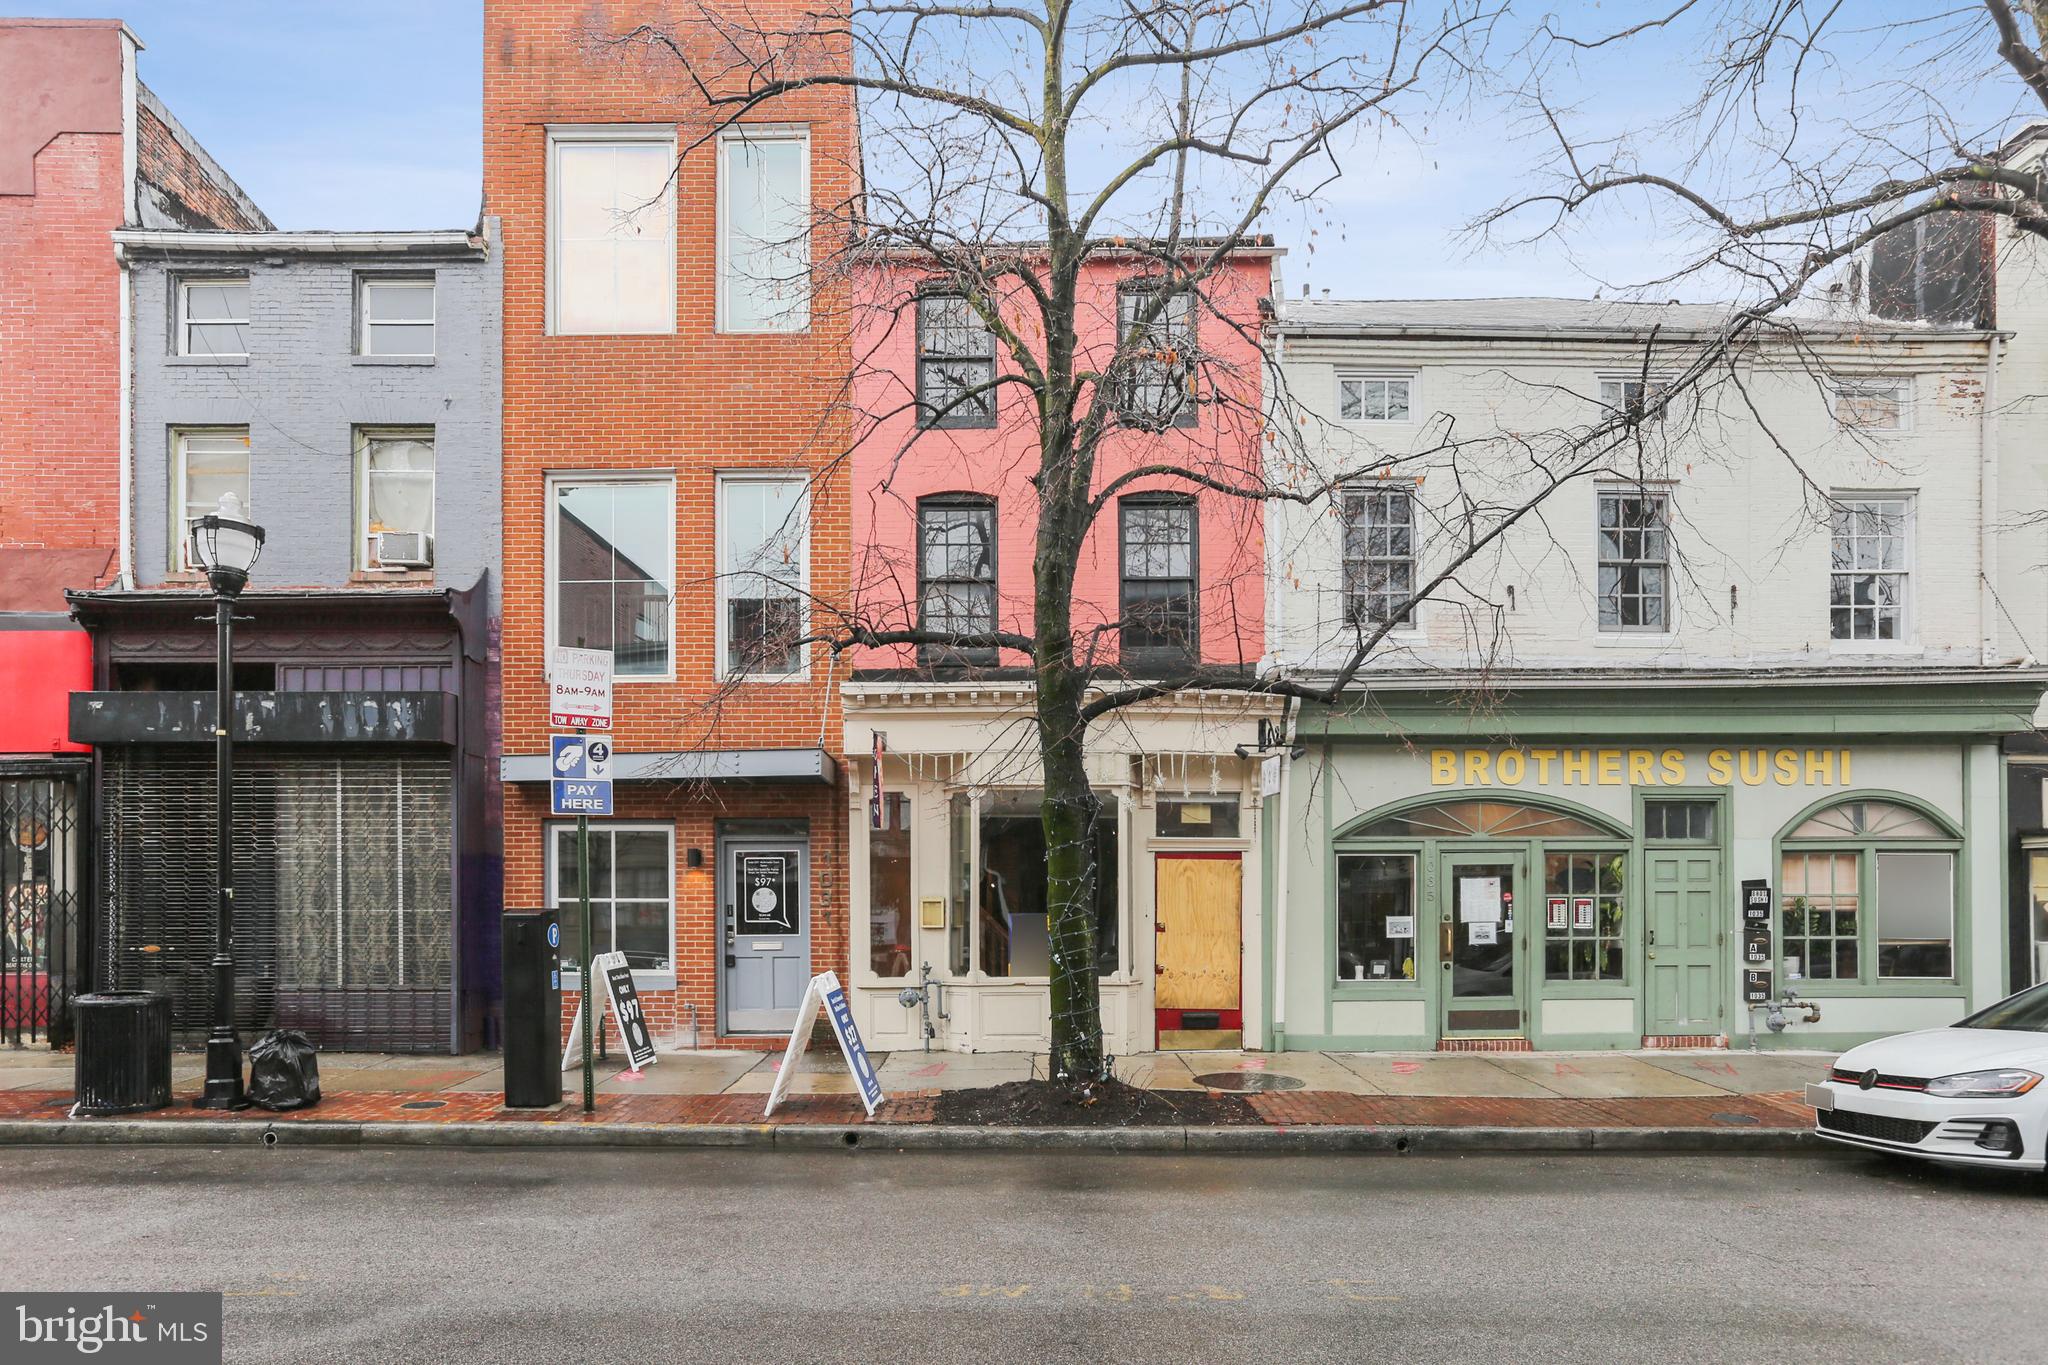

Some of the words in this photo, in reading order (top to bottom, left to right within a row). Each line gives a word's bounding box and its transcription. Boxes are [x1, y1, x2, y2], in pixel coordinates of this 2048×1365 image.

[572, 652, 609, 666] PARKING
[559, 668, 606, 683] THURSDAY
[556, 684, 606, 698] 8AM-9AM
[554, 715, 568, 725] TOW
[570, 717, 589, 727] AWAY
[591, 718, 609, 728] ZONE
[592, 743, 604, 756] 4
[1431, 749, 1687, 786] BROTHERS
[1707, 749, 1850, 786] SUSHI
[567, 784, 598, 796] PAY
[561, 798, 605, 810] HERE
[620, 999, 640, 1024] $97
